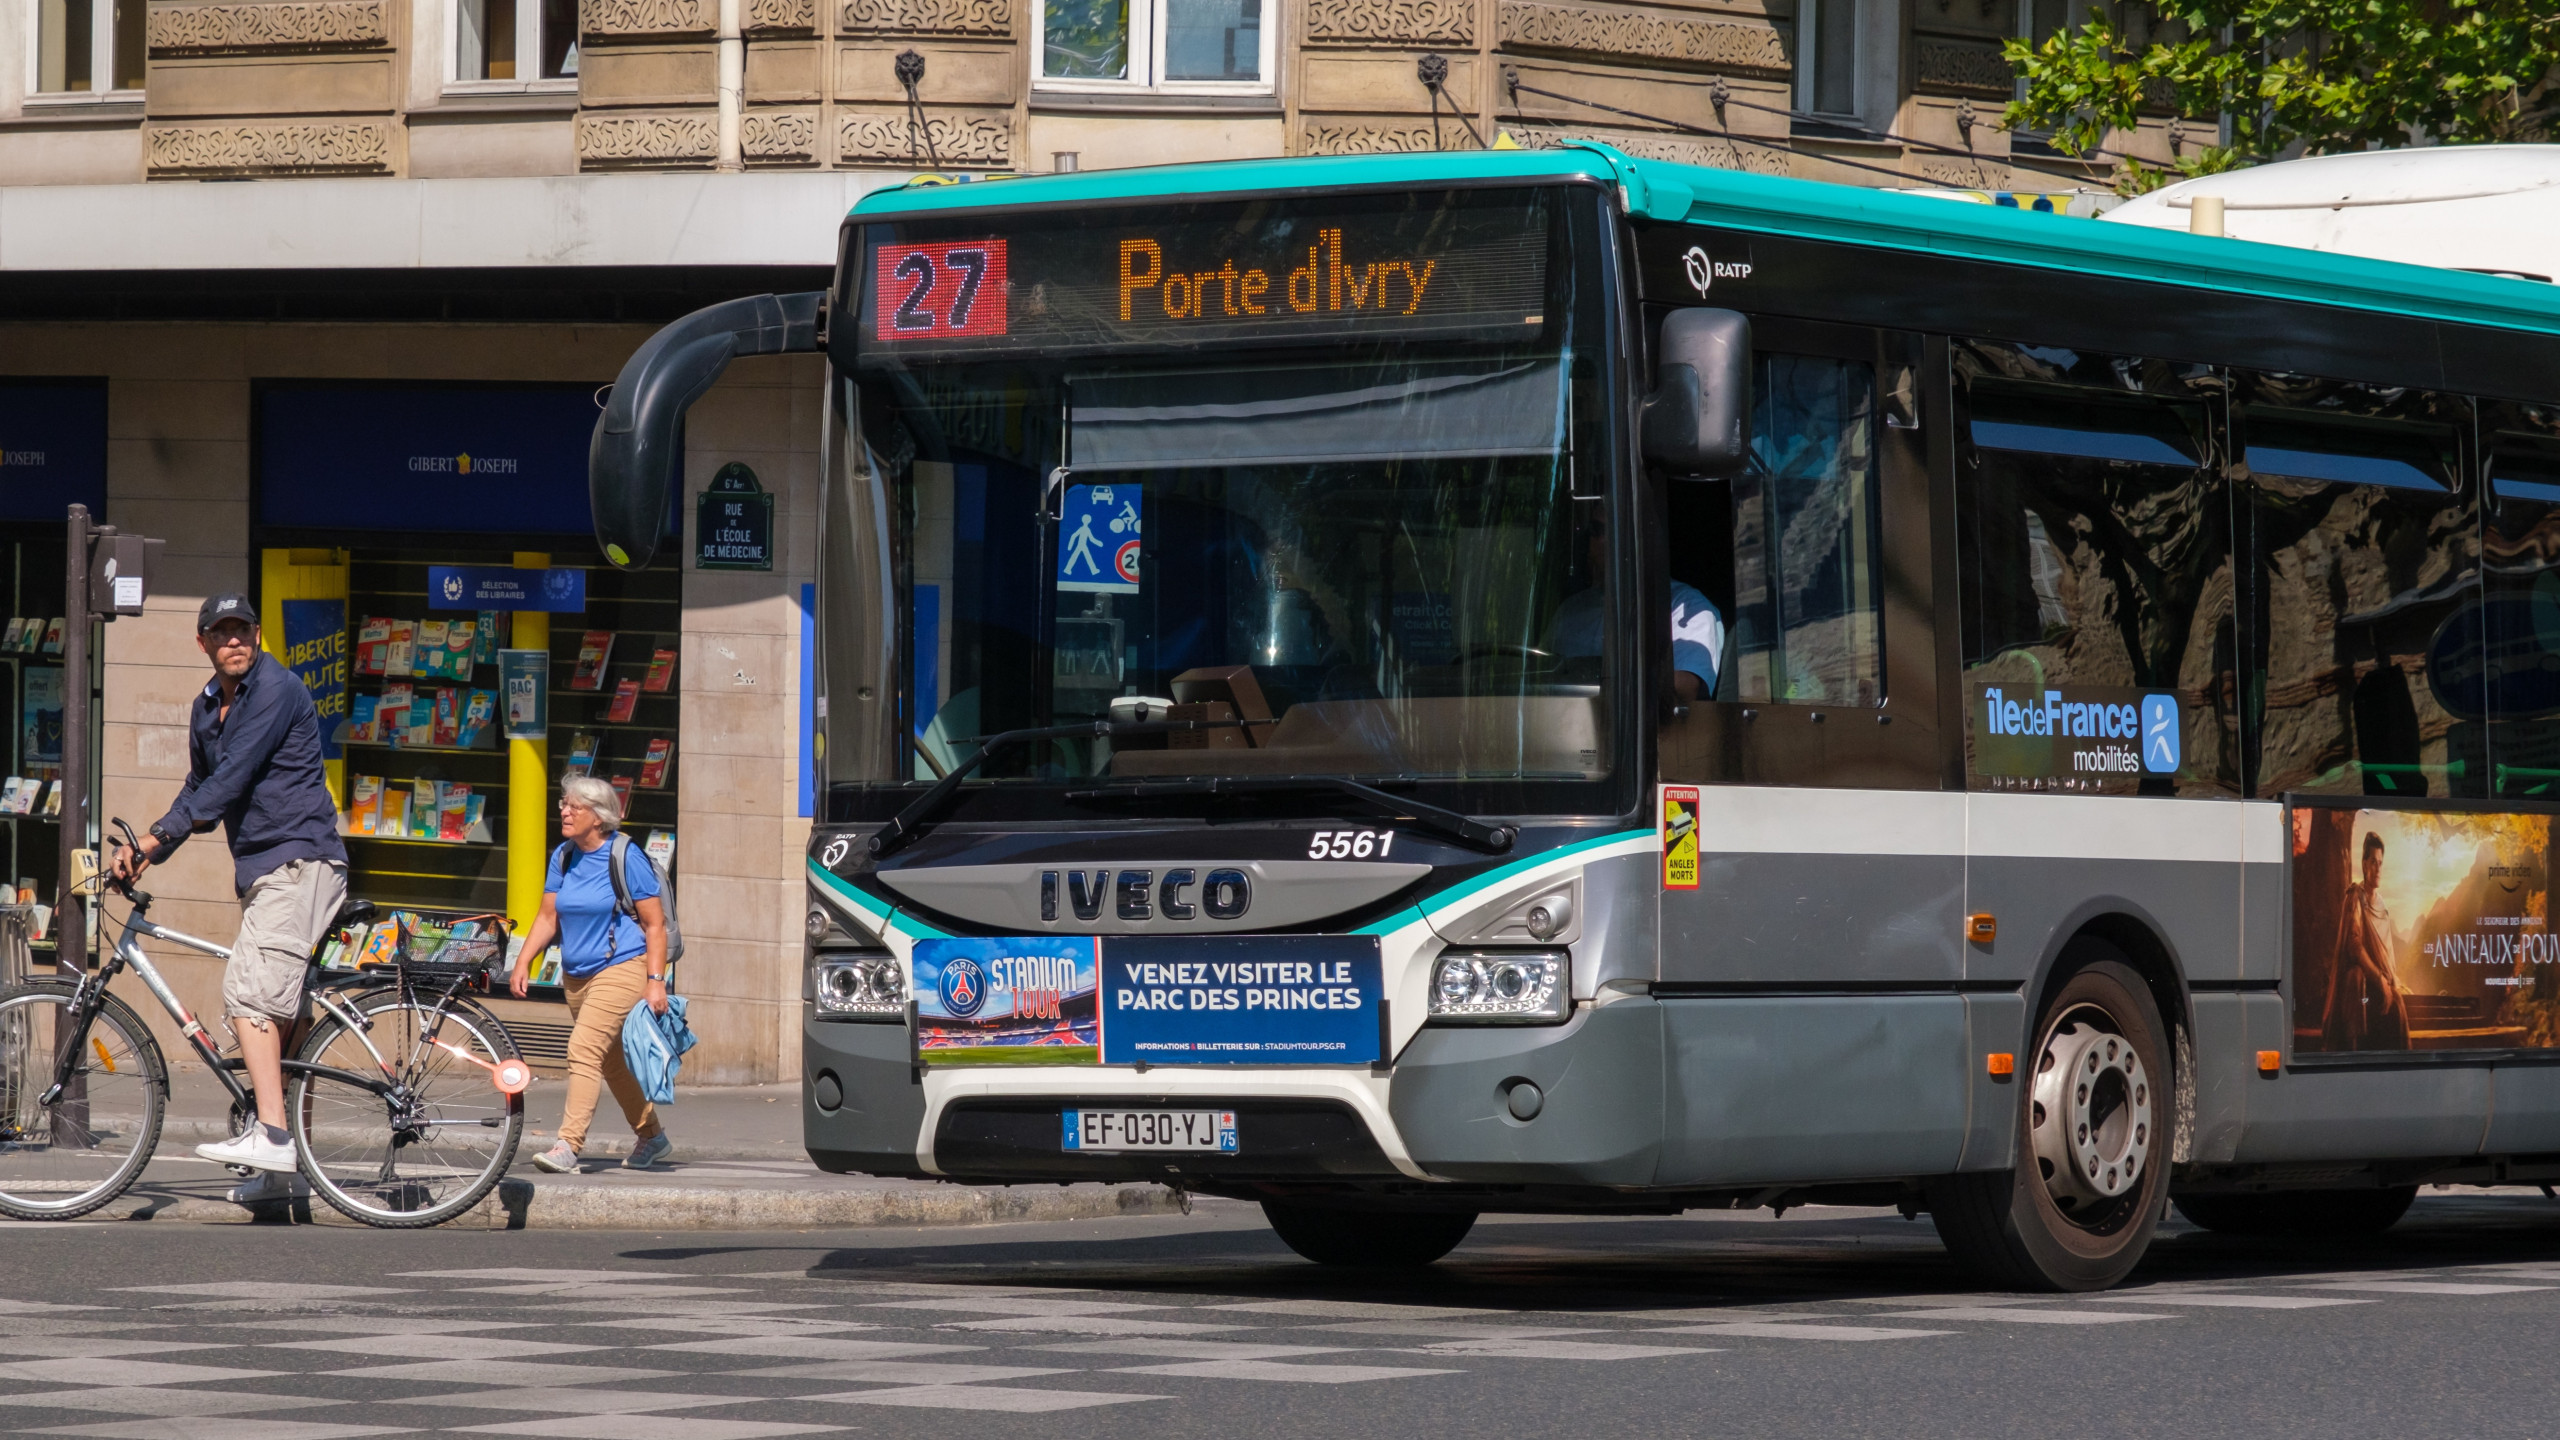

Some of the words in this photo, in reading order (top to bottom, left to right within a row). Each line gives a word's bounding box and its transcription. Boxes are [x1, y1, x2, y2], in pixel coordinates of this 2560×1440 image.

[1715, 262, 1751, 278] RATP
[893, 248, 988, 331] 27
[1119, 239, 1269, 321] Porte
[1288, 228, 1435, 315] d'Ivry
[4, 451, 45, 465] JOSEPH
[408, 457, 454, 471] GIBERT
[472, 458, 517, 473] JOSEPH
[725, 503, 743, 516] RUE
[716, 527, 751, 542] L'ÉCOLE
[704, 545, 715, 557] DE
[718, 543, 763, 558] MÉDECINE
[482, 580, 518, 589] SÉLECTION
[476, 591, 488, 599] DES
[490, 591, 525, 599] LIBRAIRES
[1393, 603, 1431, 617] etrait
[1435, 603, 1453, 617] Co
[478, 617, 493, 632] CE1
[303, 657, 345, 692] ALITÉ
[510, 680, 532, 695] BAC
[2074, 744, 2139, 772] mobilités
[1666, 790, 1697, 799] ATTENTION
[1308, 831, 1394, 859] 5561
[1669, 859, 1694, 869] ANGLES
[2488, 863, 2510, 880] prime
[2512, 863, 2531, 877] video
[1670, 871, 1693, 880] MORTS
[1040, 868, 1252, 922] IVECO
[2424, 943, 2434, 953] LES
[2432, 934, 2514, 967] ANNEAUX
[2513, 944, 2520, 953] DE
[947, 962, 977, 976] PARIS
[991, 956, 1077, 992] STADIUM
[1125, 963, 1208, 985] VENEZ
[1212, 963, 1313, 984] VISITER
[1320, 961, 1352, 984] LE
[1011, 987, 1061, 1019] TOUR
[1118, 989, 1183, 1010] PARC
[1190, 989, 1240, 1010] DES
[1246, 988, 1362, 1010] PRINCES
[1265, 1042, 1346, 1050] STADIUMTOUR.PSG.FR
[1068, 1132, 1074, 1142] F
[1084, 1114, 1214, 1145] EF-030-YJ
[1221, 1131, 1236, 1147] 75
